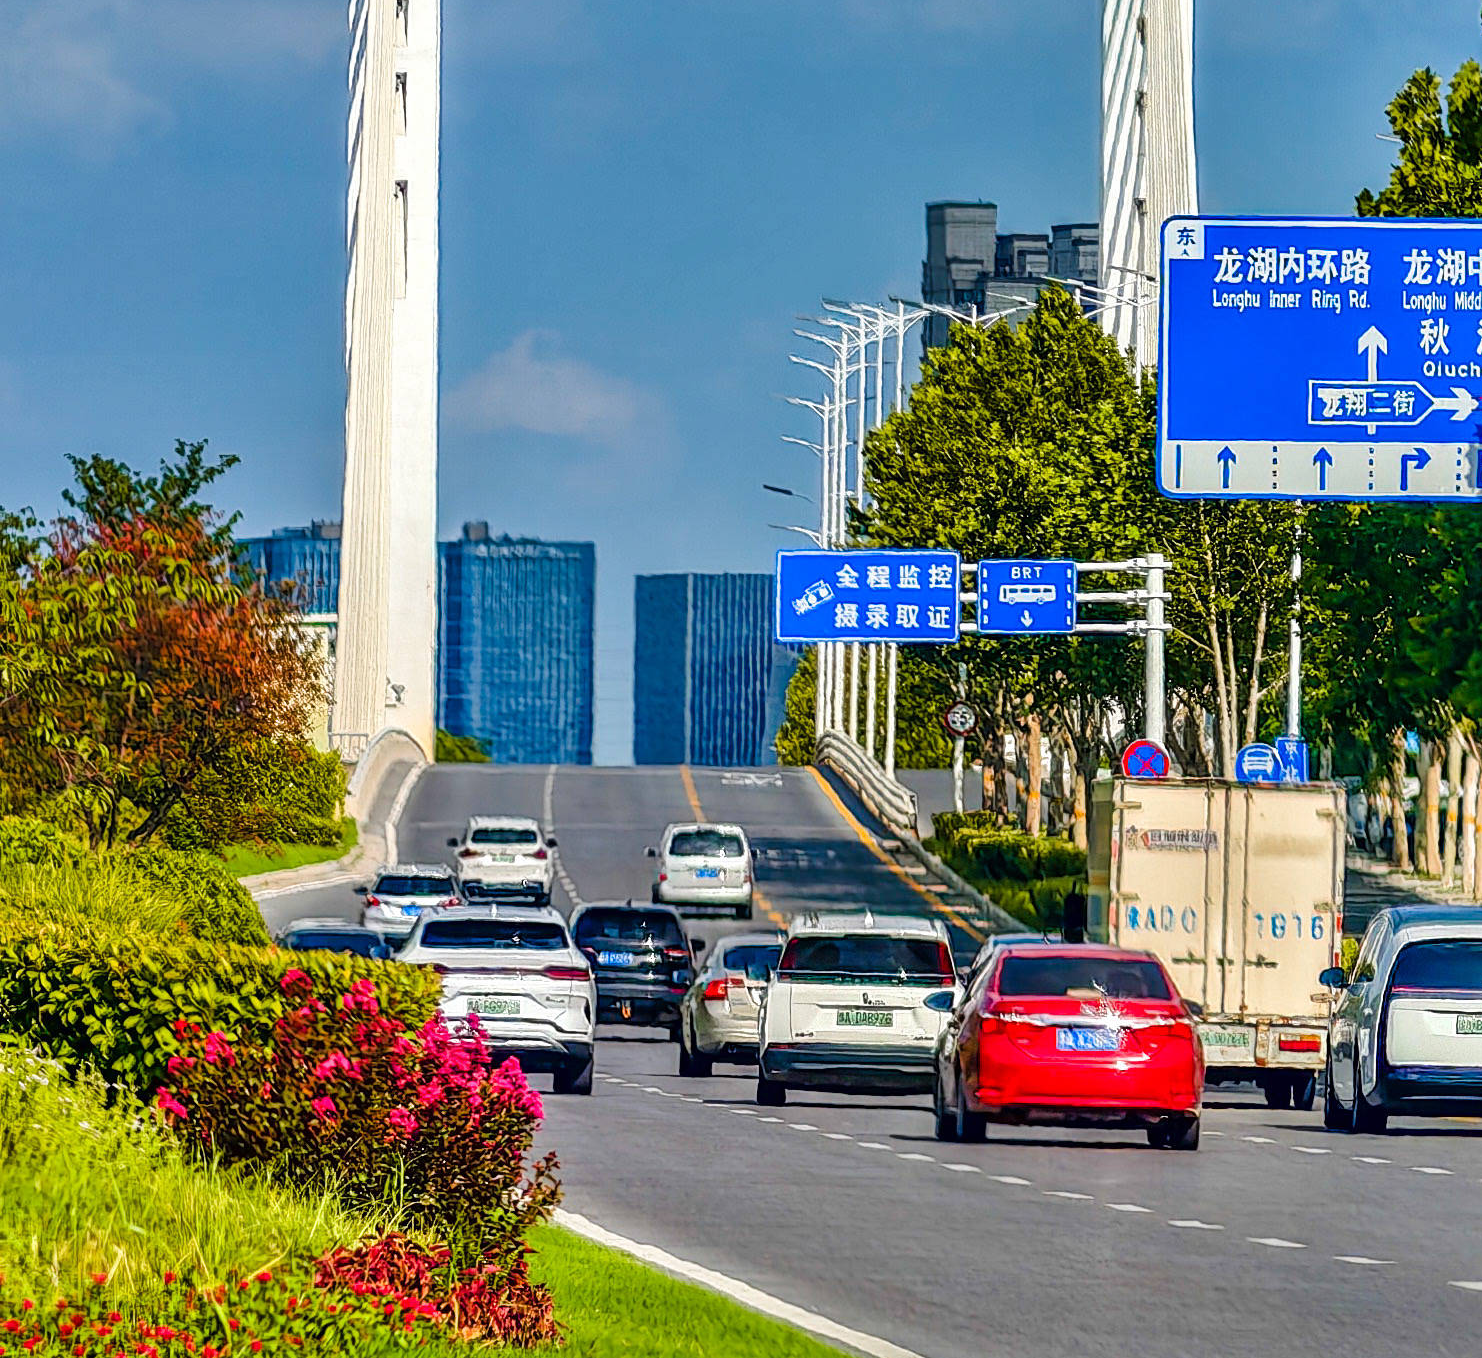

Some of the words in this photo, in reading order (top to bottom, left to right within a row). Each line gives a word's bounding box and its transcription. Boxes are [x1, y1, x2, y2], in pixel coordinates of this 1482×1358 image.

[1176, 227, 1196, 245] 东
[1213, 247, 1371, 285] 龙湖内环路
[1212, 288, 1260, 313] Longhu
[1269, 289, 1301, 308] Inner
[1311, 289, 1341, 314] Ring
[1348, 289, 1371, 308] Rd.
[1402, 290, 1446, 315] Longhu
[835, 564, 953, 589] 全程监控
[1011, 566, 1042, 580] BRT
[834, 603, 951, 629] 摄录取证
